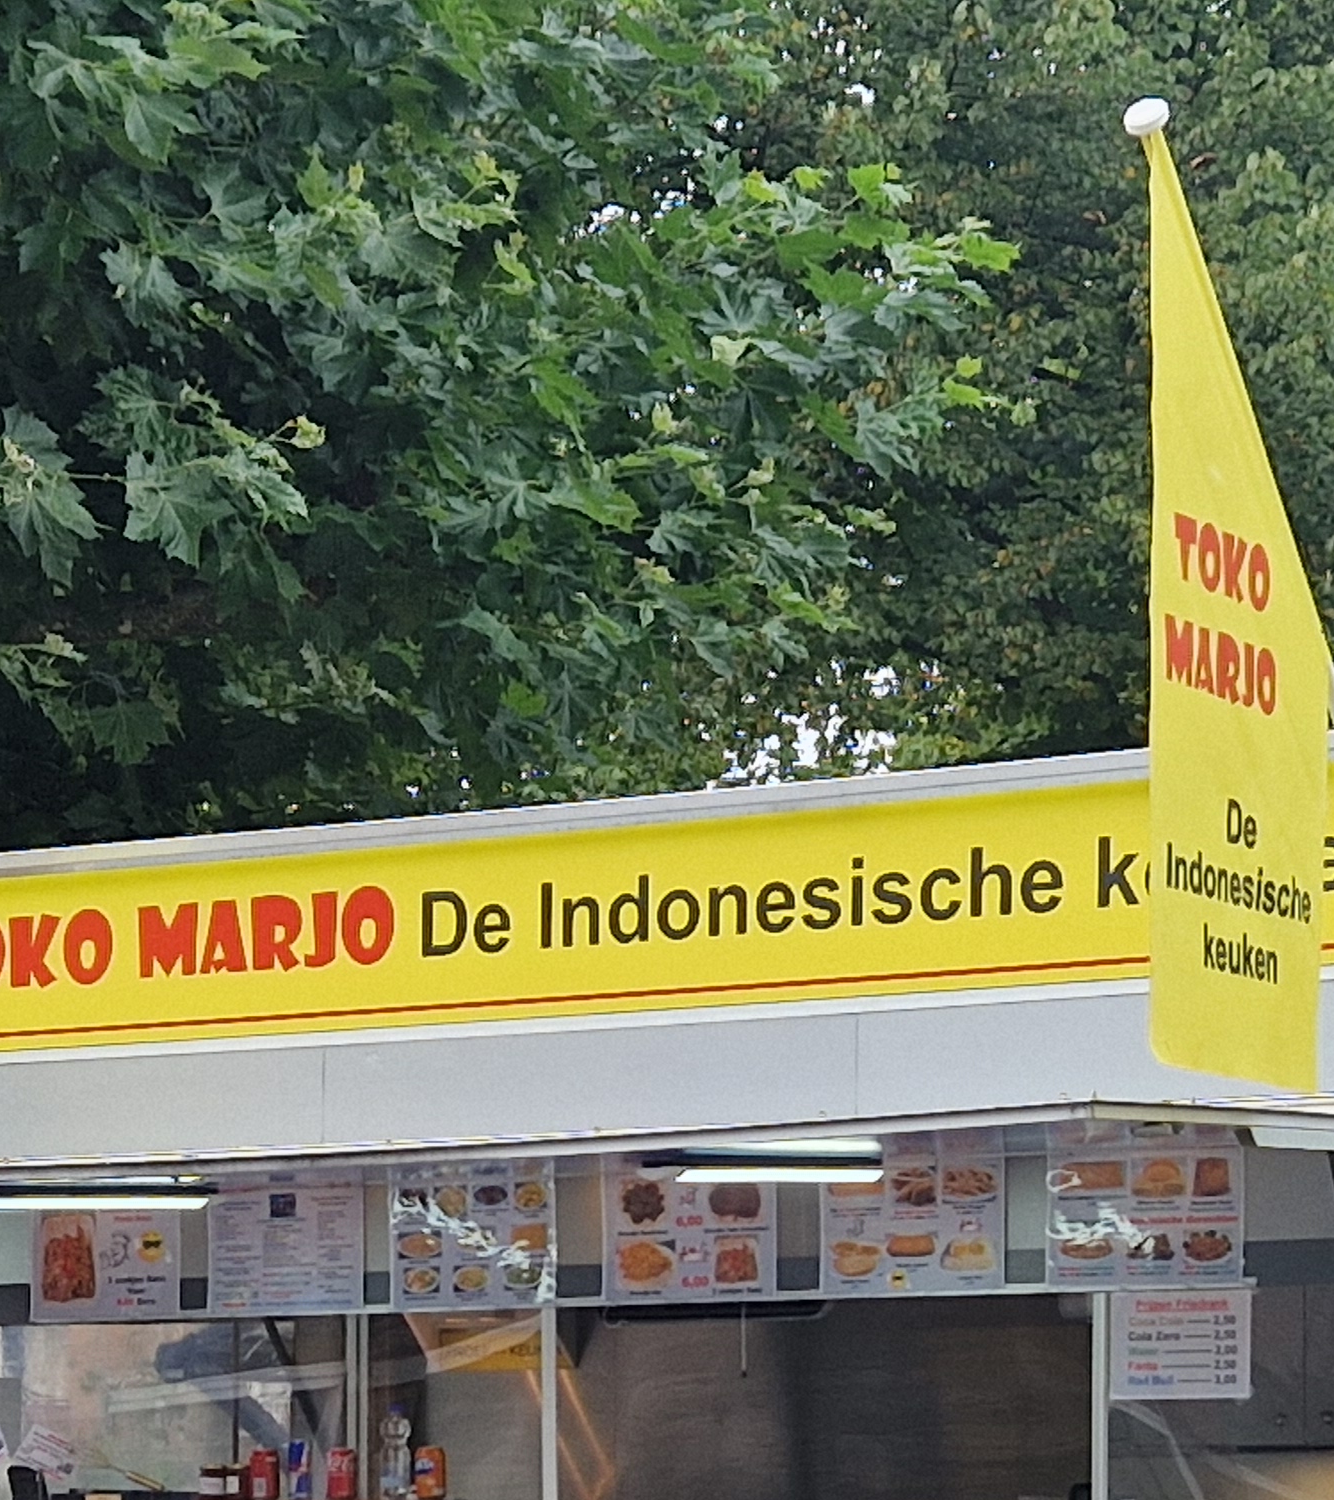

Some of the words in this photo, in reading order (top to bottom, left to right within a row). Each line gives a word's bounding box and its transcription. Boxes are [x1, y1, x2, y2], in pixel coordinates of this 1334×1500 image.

[1173, 511, 1271, 612] TOKO
[1164, 613, 1277, 716] MARJO
[1226, 798, 1257, 849] De
[138, 885, 395, 981] MARJO
[420, 890, 511, 958] De
[540, 846, 1064, 949] Indonesische
[1166, 842, 1312, 925] Indonesische
[1203, 923, 1278, 984] keuken
